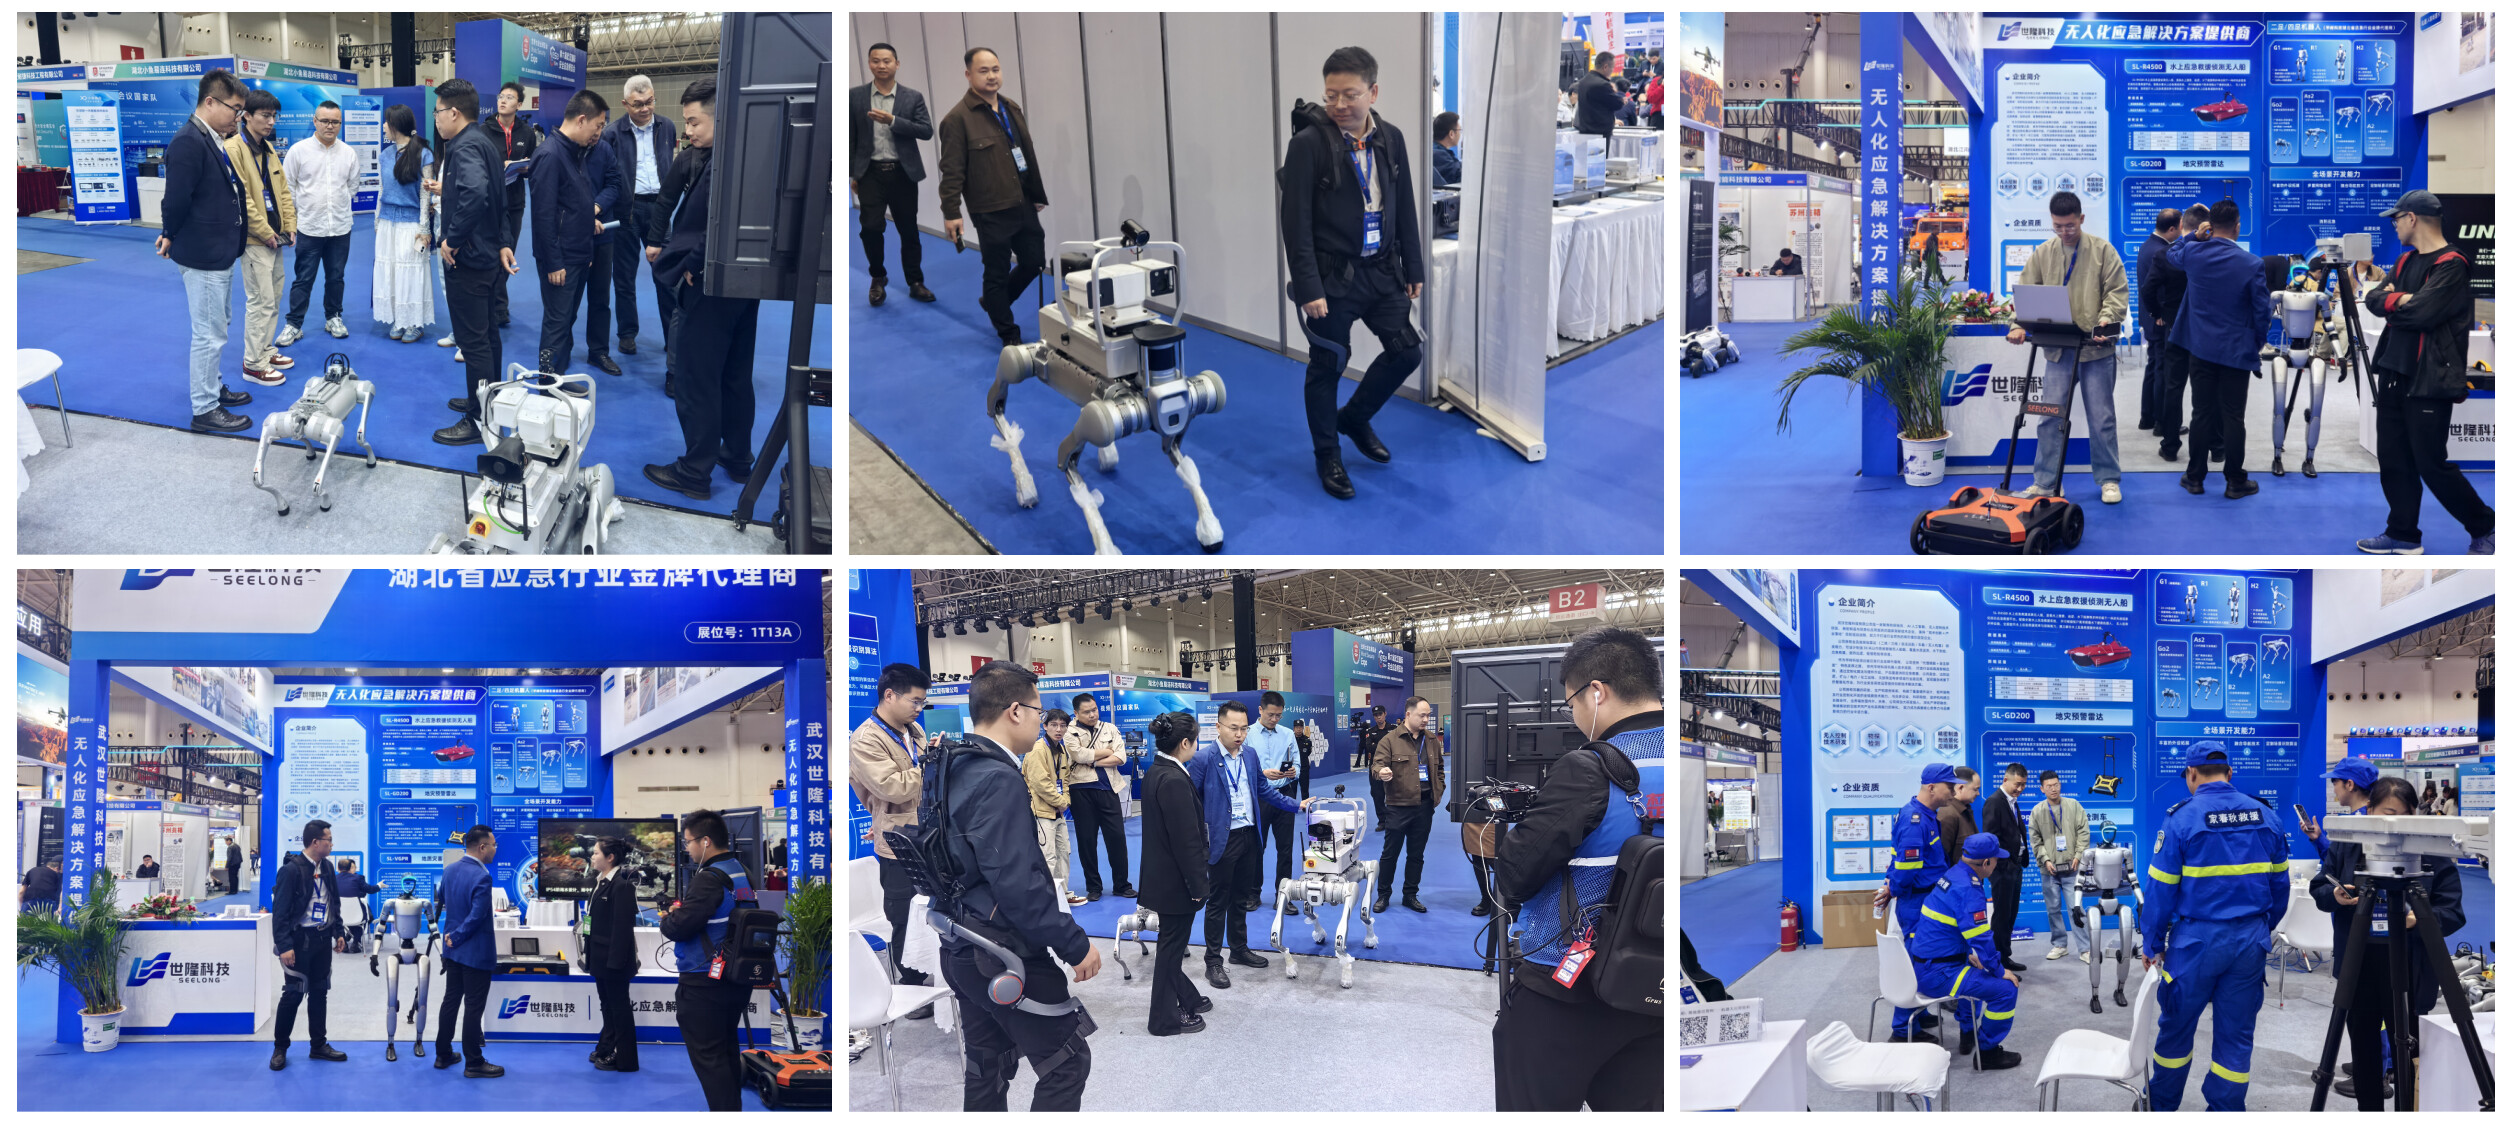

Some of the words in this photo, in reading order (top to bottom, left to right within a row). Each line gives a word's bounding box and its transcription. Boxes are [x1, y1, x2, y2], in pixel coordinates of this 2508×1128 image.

[2064, 24, 2251, 41] 无人化应急解决方案提供商
[2012, 73, 2041, 81] 企业简介
[2182, 160, 2225, 168] 地灾预警雷达
[2312, 170, 2361, 178] 全场景开发能力
[2013, 219, 2042, 227] 企业资质
[2458, 224, 2495, 239] UN
[2027, 404, 2059, 414] SEELONG
[2449, 424, 2495, 436] 世隆科
[223, 575, 304, 586] SEELONG
[1558, 589, 1585, 609] B2
[1838, 597, 1875, 608] 企业简介
[1992, 593, 2030, 602] SL-R4500
[2038, 595, 2128, 607] 水上应急救援侦测无人船
[335, 688, 476, 701] 无人化应急解决方案提供商
[1991, 712, 2031, 720] SL-GD200
[2055, 712, 2104, 721] 地灾预警雷达
[2203, 726, 2256, 735] 全场景开发能力
[1842, 783, 1880, 792] 企业资质
[169, 962, 230, 976] 世隆科技
[1644, 996, 1662, 1005] Grus
[529, 1002, 576, 1013] 世隆科技
